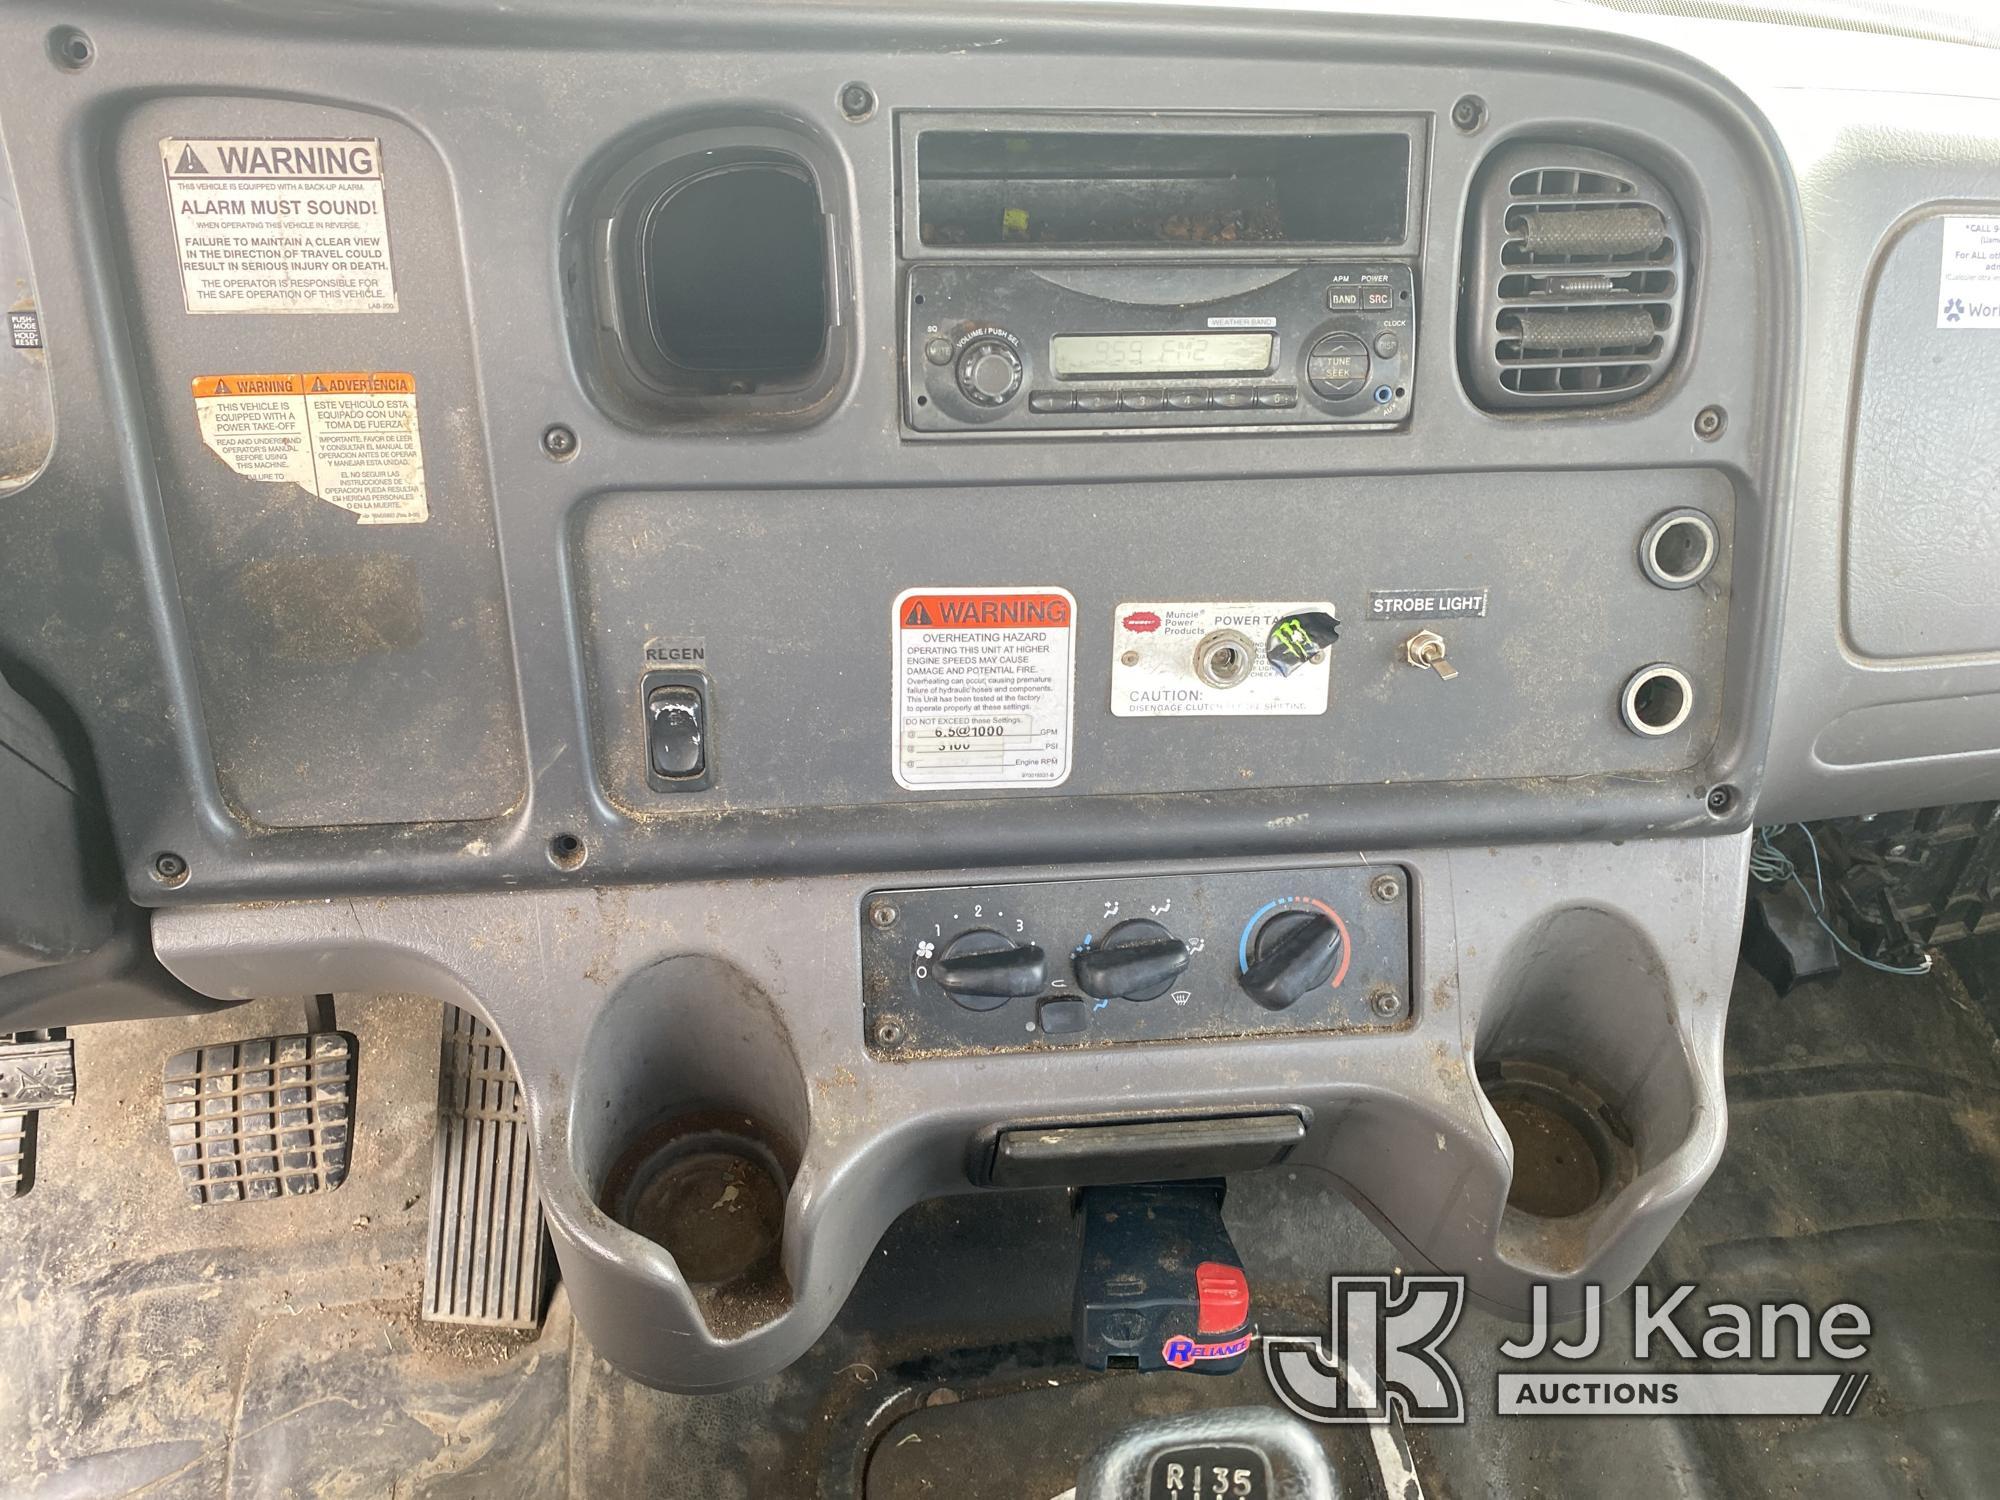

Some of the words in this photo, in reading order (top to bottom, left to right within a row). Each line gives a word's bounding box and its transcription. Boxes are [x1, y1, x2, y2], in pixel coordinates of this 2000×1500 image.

[217, 147, 372, 174] WARNING
[181, 200, 245, 214] ALARM
[252, 200, 300, 214] MUST
[307, 200, 377, 214] SOUND!
[185, 238, 230, 246] FAILURE
[236, 238, 248, 246] TO
[251, 238, 301, 246] MAINTAIN
[305, 238, 312, 246] A
[315, 238, 350, 246] CLEAR
[353, 238, 380, 246] VIEW
[187, 250, 196, 258] IN
[201, 250, 221, 258] THE
[224, 250, 280, 258] DIRECTION
[285, 250, 298, 258] OF
[301, 250, 343, 258] TRAVEL
[345, 250, 381, 258] COULD
[184, 262, 224, 271] RESULT
[228, 262, 239, 271] IN
[242, 262, 288, 271] SERIOUS
[291, 262, 328, 271] INJURY
[332, 262, 347, 271] OR
[350, 262, 387, 271] DEATH.
[197, 290, 216, 299] THE
[219, 290, 244, 299] SAFE
[247, 290, 302, 299] OPERATION
[305, 290, 317, 299] OF
[320, 290, 340, 299] THIS
[343, 290, 385, 299] VEHICLE.
[1333, 295, 1356, 303] BAND
[1369, 295, 1387, 303] SRC
[957, 328, 983, 348] VOLUME
[988, 328, 1007, 337] PUSH
[1007, 334, 1019, 347] SEL
[1327, 369, 1350, 377] SEEK
[237, 381, 292, 392] WARNING
[318, 411, 362, 419] EQUIPADO
[366, 411, 385, 419] CON
[251, 423, 295, 431] TAKE-OFF
[325, 421, 351, 429] TOMA
[369, 420, 402, 428] FUERZA
[236, 461, 252, 469] THIS
[1373, 598, 1434, 612] STROBE
[1439, 597, 1482, 610] LIGHT
[939, 601, 1066, 624] WARNING
[1166, 619, 1193, 627] Power
[1215, 616, 1260, 625] POWER
[1165, 627, 1204, 635] Products
[923, 633, 999, 643] OVERHEATING
[1003, 632, 1046, 641] HAZARD
[646, 648, 704, 660] REGEN
[907, 667, 944, 675] DAMAGE
[907, 678, 949, 686] Overheating
[988, 677, 1014, 685] causing
[1017, 676, 1051, 684] premature
[939, 687, 970, 695] hydraulic
[1009, 686, 1053, 694] components.
[1130, 690, 1202, 702] CAUTION:
[1129, 704, 1182, 712] DISENGAGE
[935, 726, 1003, 737] 6.5@1000
[1041, 728, 1057, 736] GPM
[1016, 758, 1038, 766] Engine
[974, 905, 982, 917] 2
[935, 924, 940, 937] 1
[1016, 920, 1024, 932] 3
